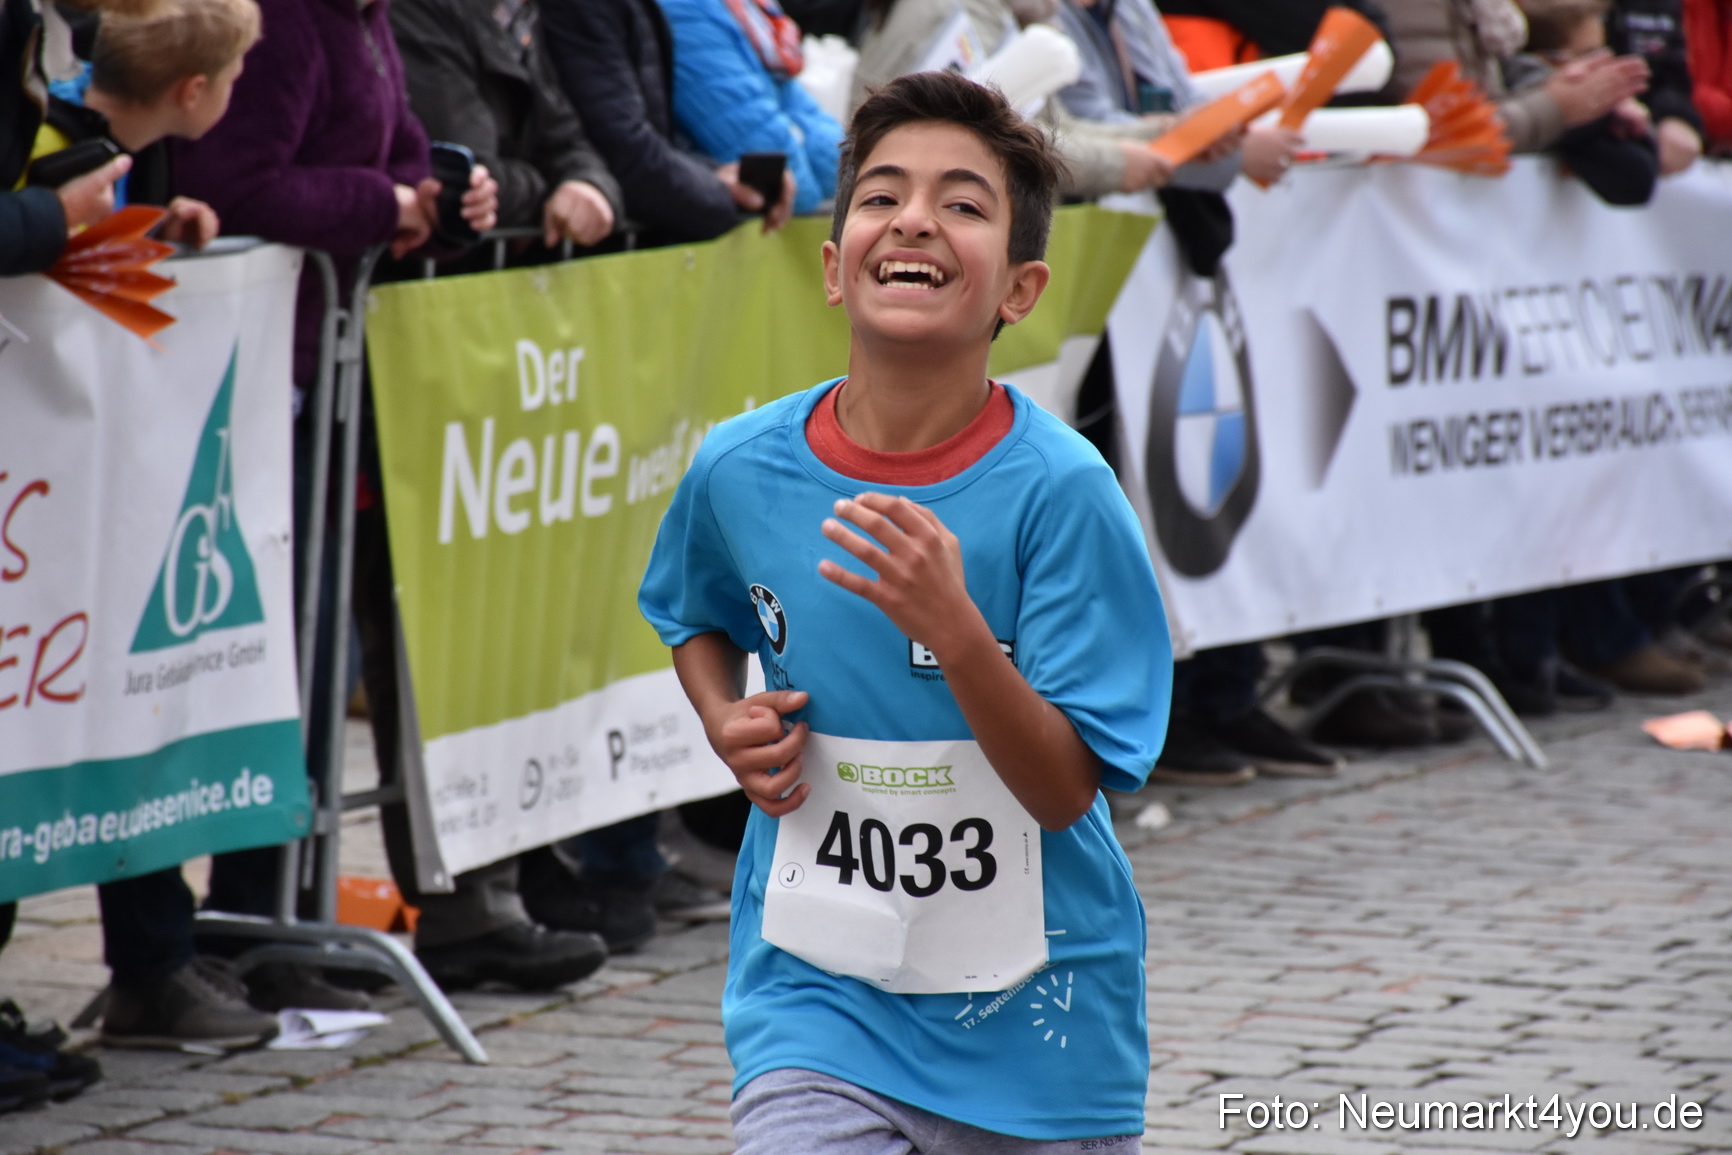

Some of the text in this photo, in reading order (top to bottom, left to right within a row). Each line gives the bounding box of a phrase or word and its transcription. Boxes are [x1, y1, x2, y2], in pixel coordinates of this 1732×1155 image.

[1386, 293, 1509, 387] BMW
[516, 338, 585, 412] Der
[439, 416, 621, 545] Neue
[750, 587, 782, 614] BMW
[123, 669, 153, 696] Jura
[860, 764, 955, 788] BOCK
[862, 786, 957, 796] inspired by smart concepts
[816, 810, 997, 898] 4033
[786, 869, 796, 882] J
[961, 1017, 981, 1030] 17.
